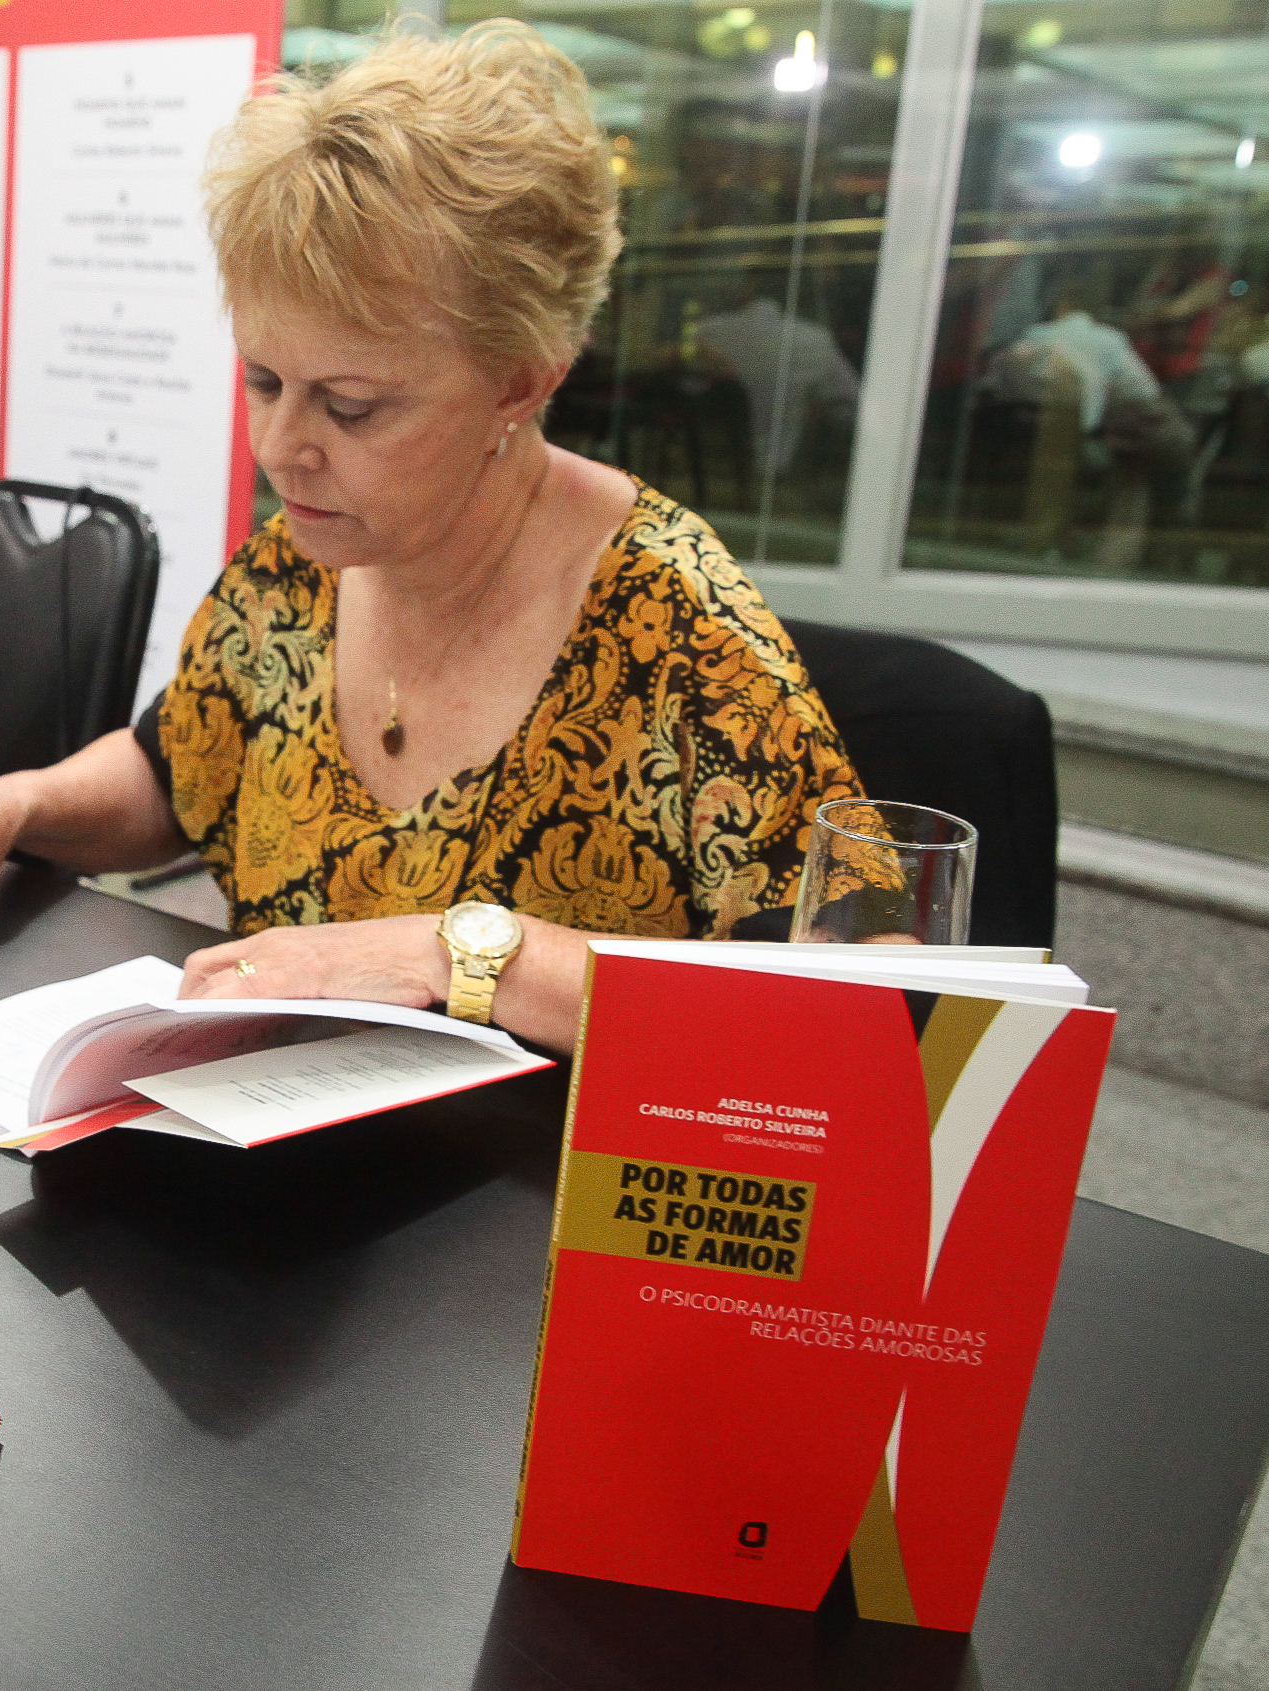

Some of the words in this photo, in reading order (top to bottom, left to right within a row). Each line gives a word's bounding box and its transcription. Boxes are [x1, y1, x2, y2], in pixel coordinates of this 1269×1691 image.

[639, 1103, 694, 1121] CARLOS
[697, 1111, 763, 1130] ROBERTO
[765, 1120, 826, 1138] SILVEIRA
[717, 1098, 773, 1115] ADELSA
[776, 1105, 830, 1122] CUNHA
[722, 1133, 824, 1154] (ORGANIZADORES)
[620, 1163, 688, 1196] POR
[697, 1173, 807, 1212] TODAS
[614, 1195, 656, 1223] AS
[665, 1201, 802, 1243] FORMAS
[646, 1230, 689, 1259] DE
[695, 1238, 796, 1275] AMOR
[639, 1286, 657, 1302] O
[660, 1289, 854, 1330] PSICODRAMATISTA
[859, 1316, 939, 1342] DIANTE
[942, 1327, 986, 1347] DAS
[749, 1321, 855, 1349] RELAÇÕES
[859, 1337, 983, 1366] AMOROSAS
